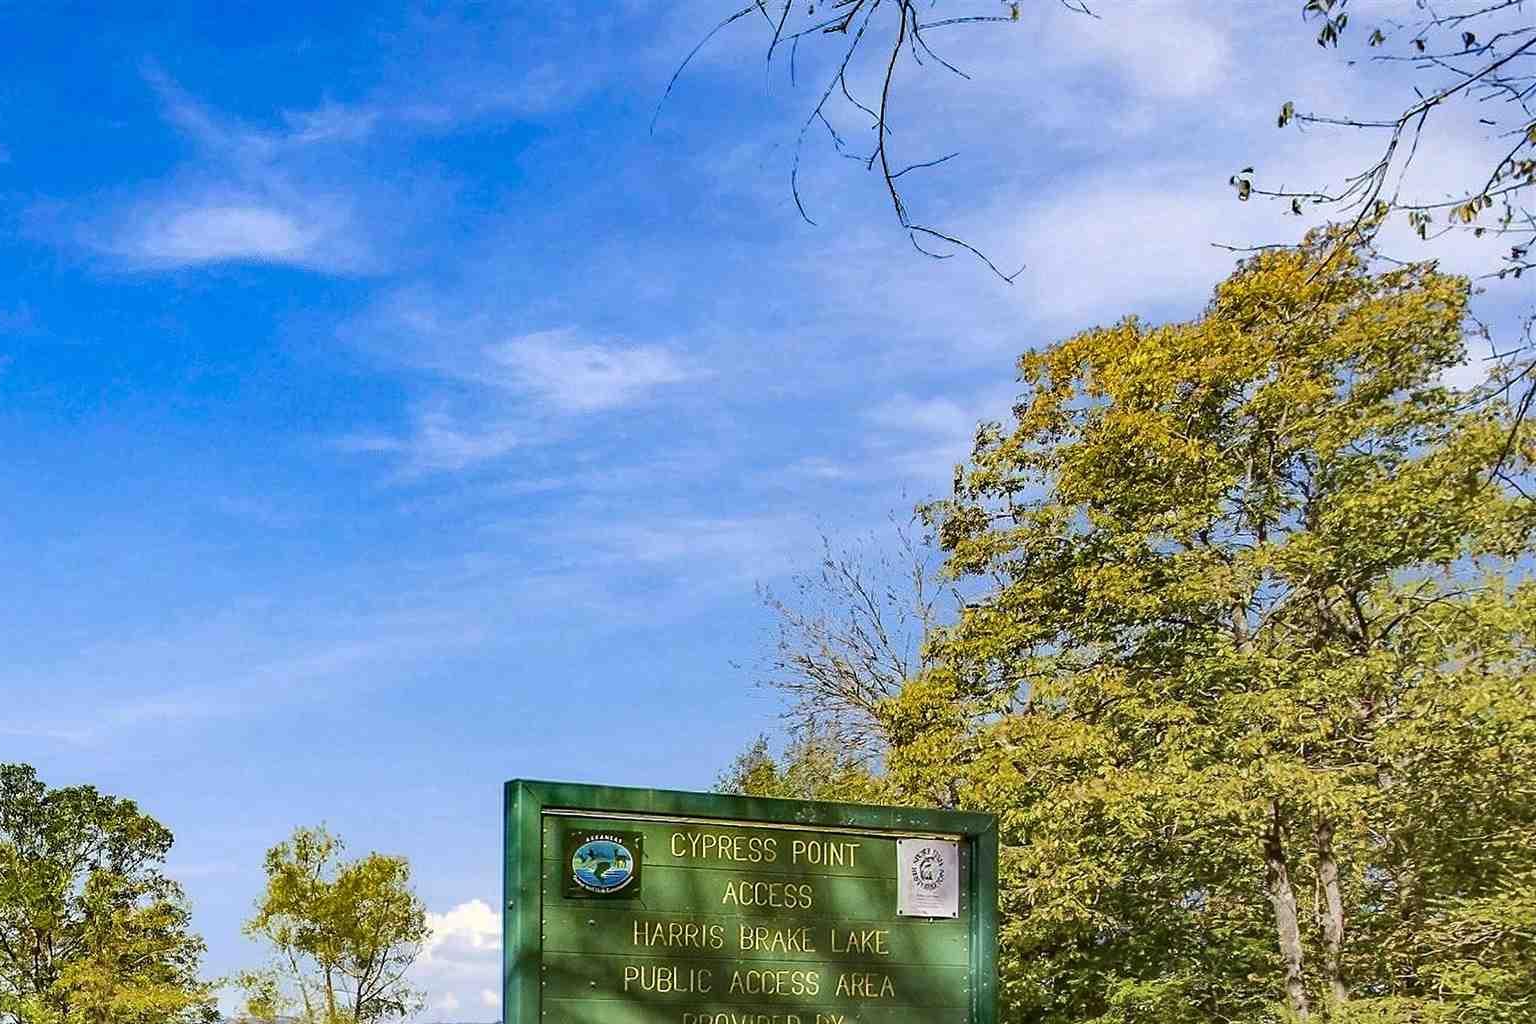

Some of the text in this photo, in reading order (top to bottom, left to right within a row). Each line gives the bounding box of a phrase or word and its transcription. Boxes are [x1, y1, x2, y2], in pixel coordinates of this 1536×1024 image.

[671, 832, 860, 867] CYPRESS POINT
[722, 881, 814, 909] ACCESS
[633, 920, 889, 955] HARRIS BRAKE LAKE
[624, 967, 895, 998] PUBLIC ACCESS AREA
